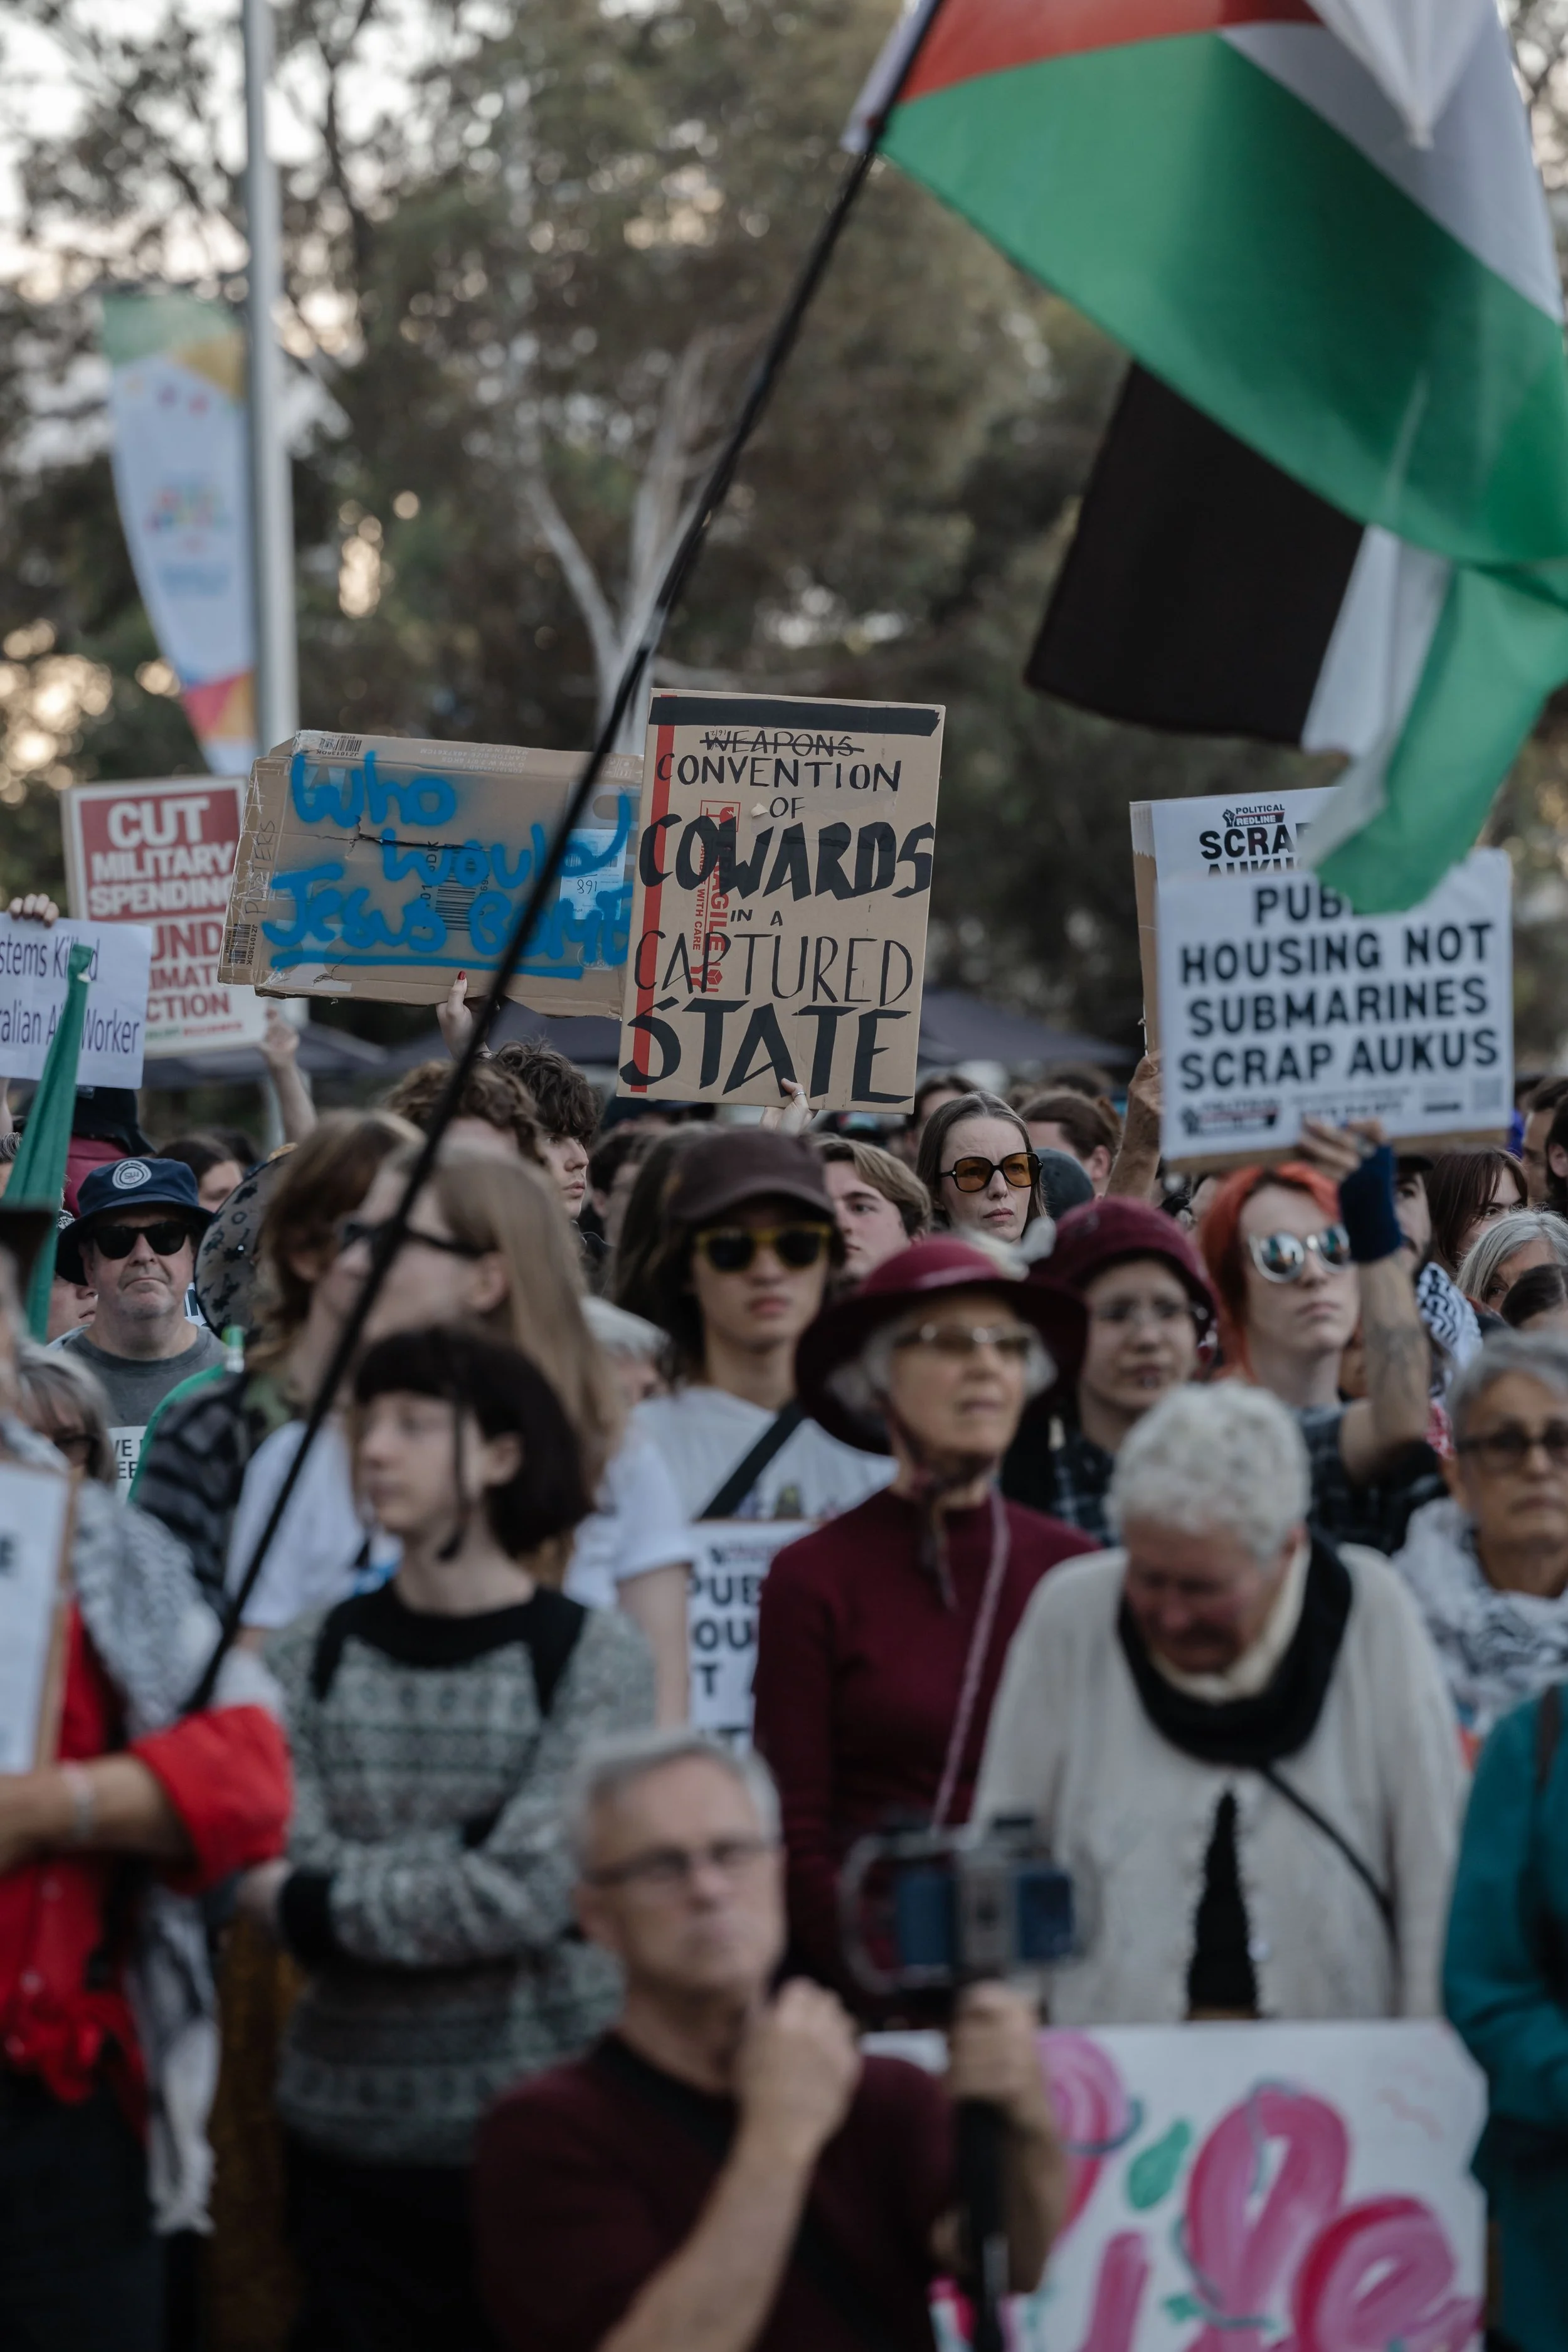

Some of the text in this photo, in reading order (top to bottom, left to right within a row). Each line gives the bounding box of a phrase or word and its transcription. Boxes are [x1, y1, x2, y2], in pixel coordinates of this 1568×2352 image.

[704, 729, 855, 757] WEAPONS
[292, 750, 457, 827] Who
[657, 753, 902, 792] CONVENTION
[107, 795, 210, 848] CUT
[769, 797, 806, 819] OF
[1236, 803, 1285, 815] POLITICAL
[1236, 815, 1276, 827] REDLINE
[91, 842, 236, 883] MILITARY
[638, 813, 936, 902] COWARDS
[576, 879, 598, 894] 168
[695, 889, 705, 916] WITH
[709, 842, 733, 951] AGILE
[1256, 884, 1343, 925] PUB
[692, 921, 702, 951] CARE
[730, 909, 783, 926] IN A
[246, 924, 258, 966] JZ10136DK
[1182, 924, 1493, 985] HOUSING NOT
[633, 930, 914, 1007] CAPTURED
[146, 991, 231, 1024] CTION
[1189, 978, 1486, 1037] SUBMARINES
[82, 1007, 140, 1054] Worker
[619, 996, 914, 1104] STATE
[1181, 1029, 1498, 1091] SCRAP AUKUS
[695, 1618, 753, 1652] OU
[698, 1662, 720, 1697] T
